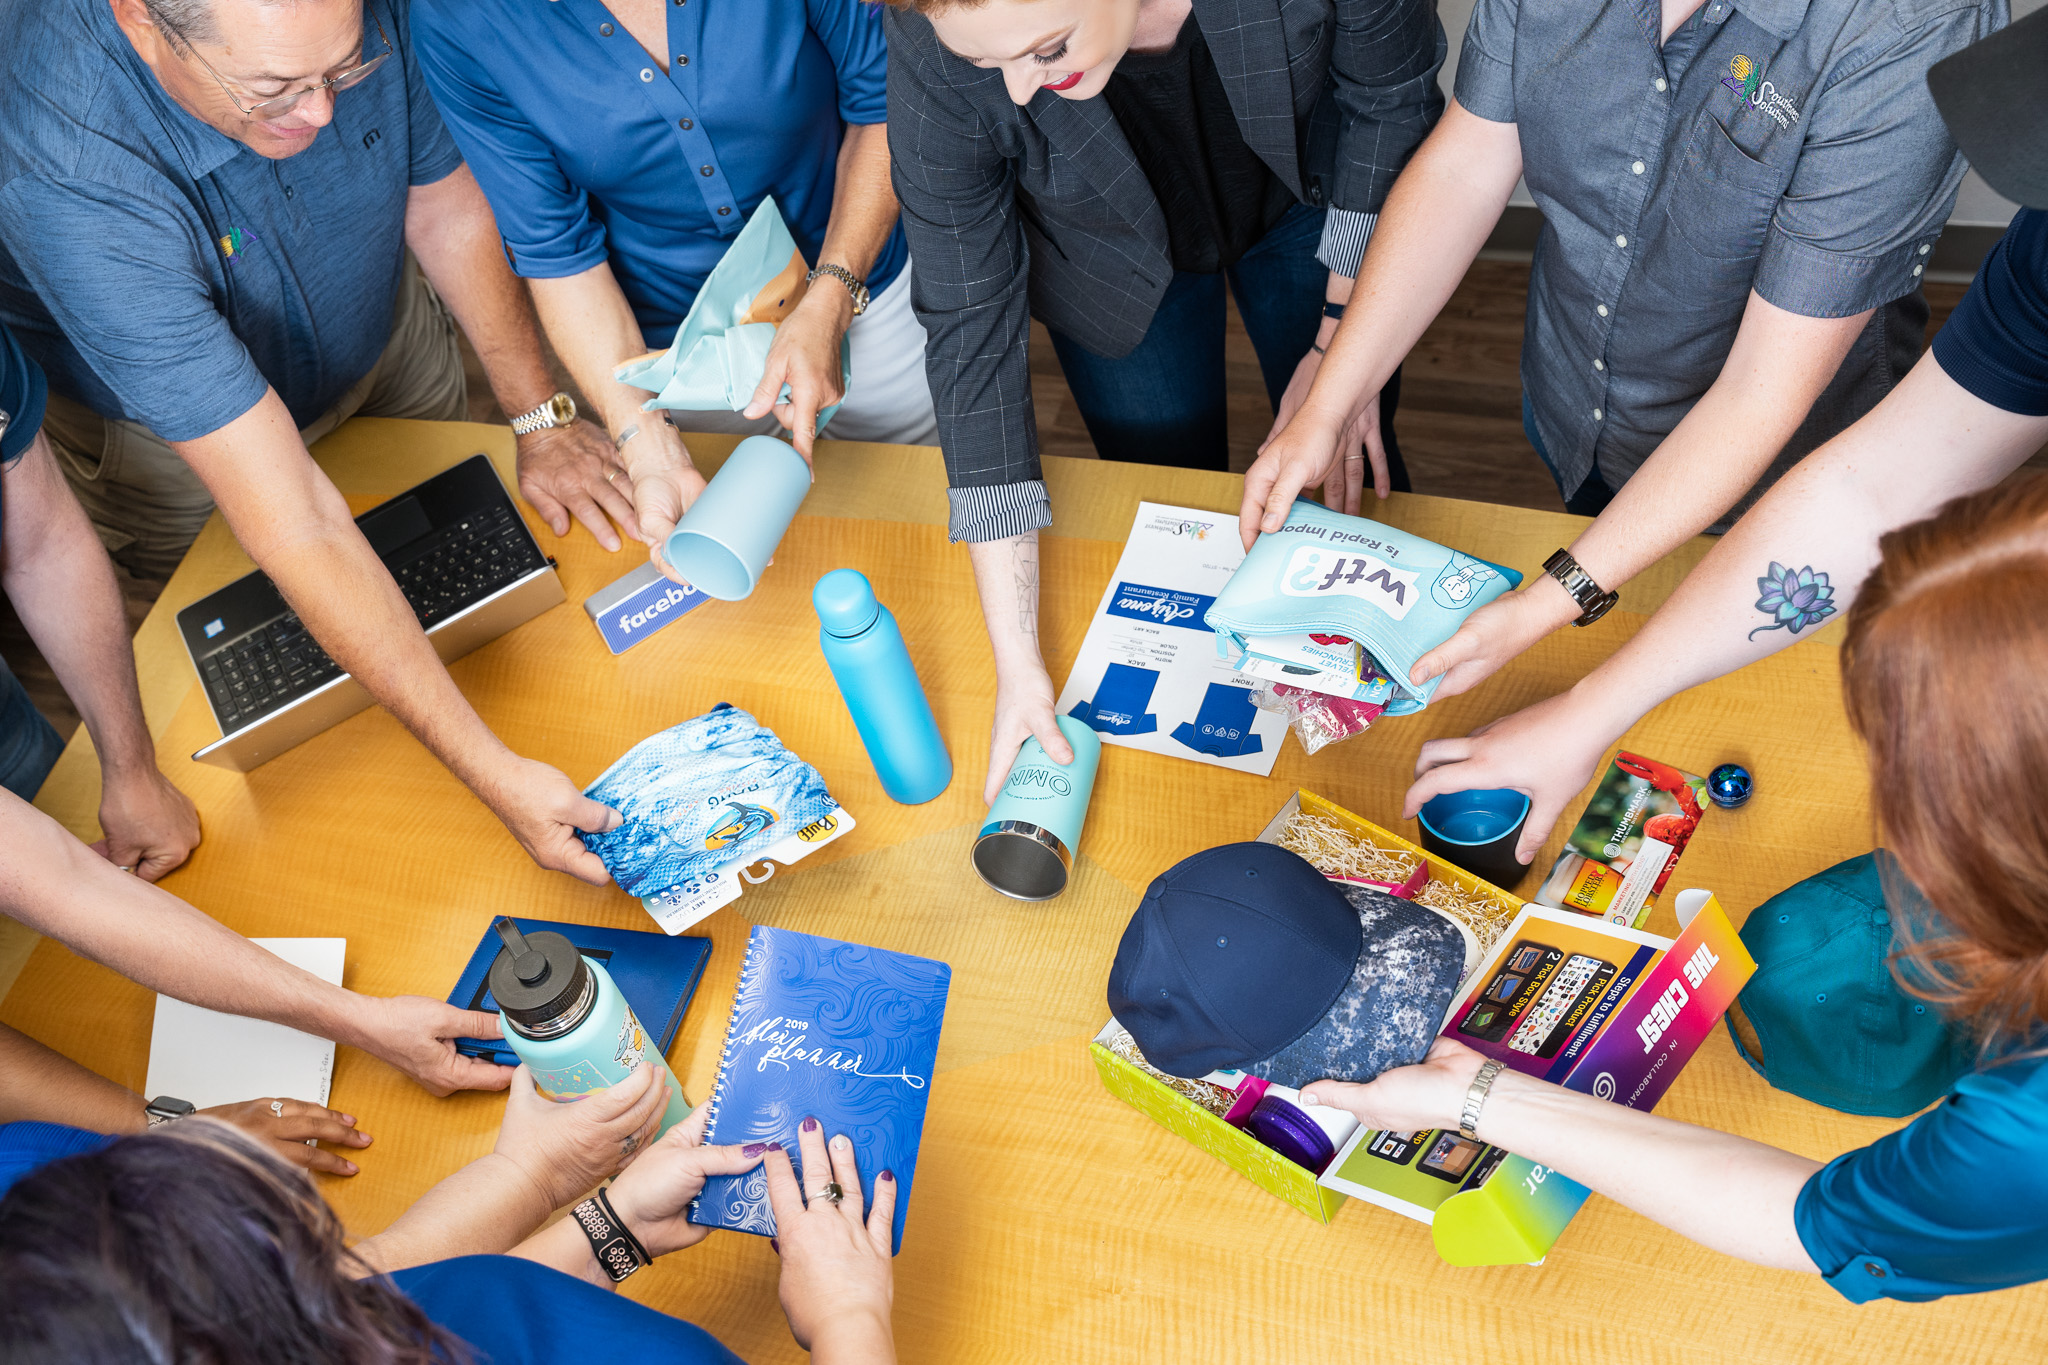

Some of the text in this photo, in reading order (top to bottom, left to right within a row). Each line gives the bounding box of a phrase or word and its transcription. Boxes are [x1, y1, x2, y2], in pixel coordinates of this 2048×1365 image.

[1329, 529, 1383, 550] Rapid
[1386, 545, 1400, 559] is
[1124, 586, 1200, 604] Family Restaurant
[1117, 598, 1196, 623] Arizona
[1126, 658, 1146, 667] BACK
[1319, 660, 1354, 676] VELVET
[1230, 678, 1255, 687] FRONT
[1611, 786, 1648, 842] THUMBMARK
[1574, 873, 1594, 905] HOPPED
[1580, 876, 1603, 908] LOBSTER
[1613, 882, 1631, 911] MARKETING
[1508, 952, 1561, 1017] 2 Pick Box Style
[1588, 978, 1608, 996] Pick
[1636, 942, 1720, 1054] THE CHEST
[784, 1018, 808, 1030] 2019
[1564, 976, 1632, 1059] Steps to fulfillment:
[1565, 996, 1594, 1027] Product
[731, 1016, 794, 1046] flex
[1668, 1040, 1678, 1051] IN
[757, 1035, 925, 1089] planner
